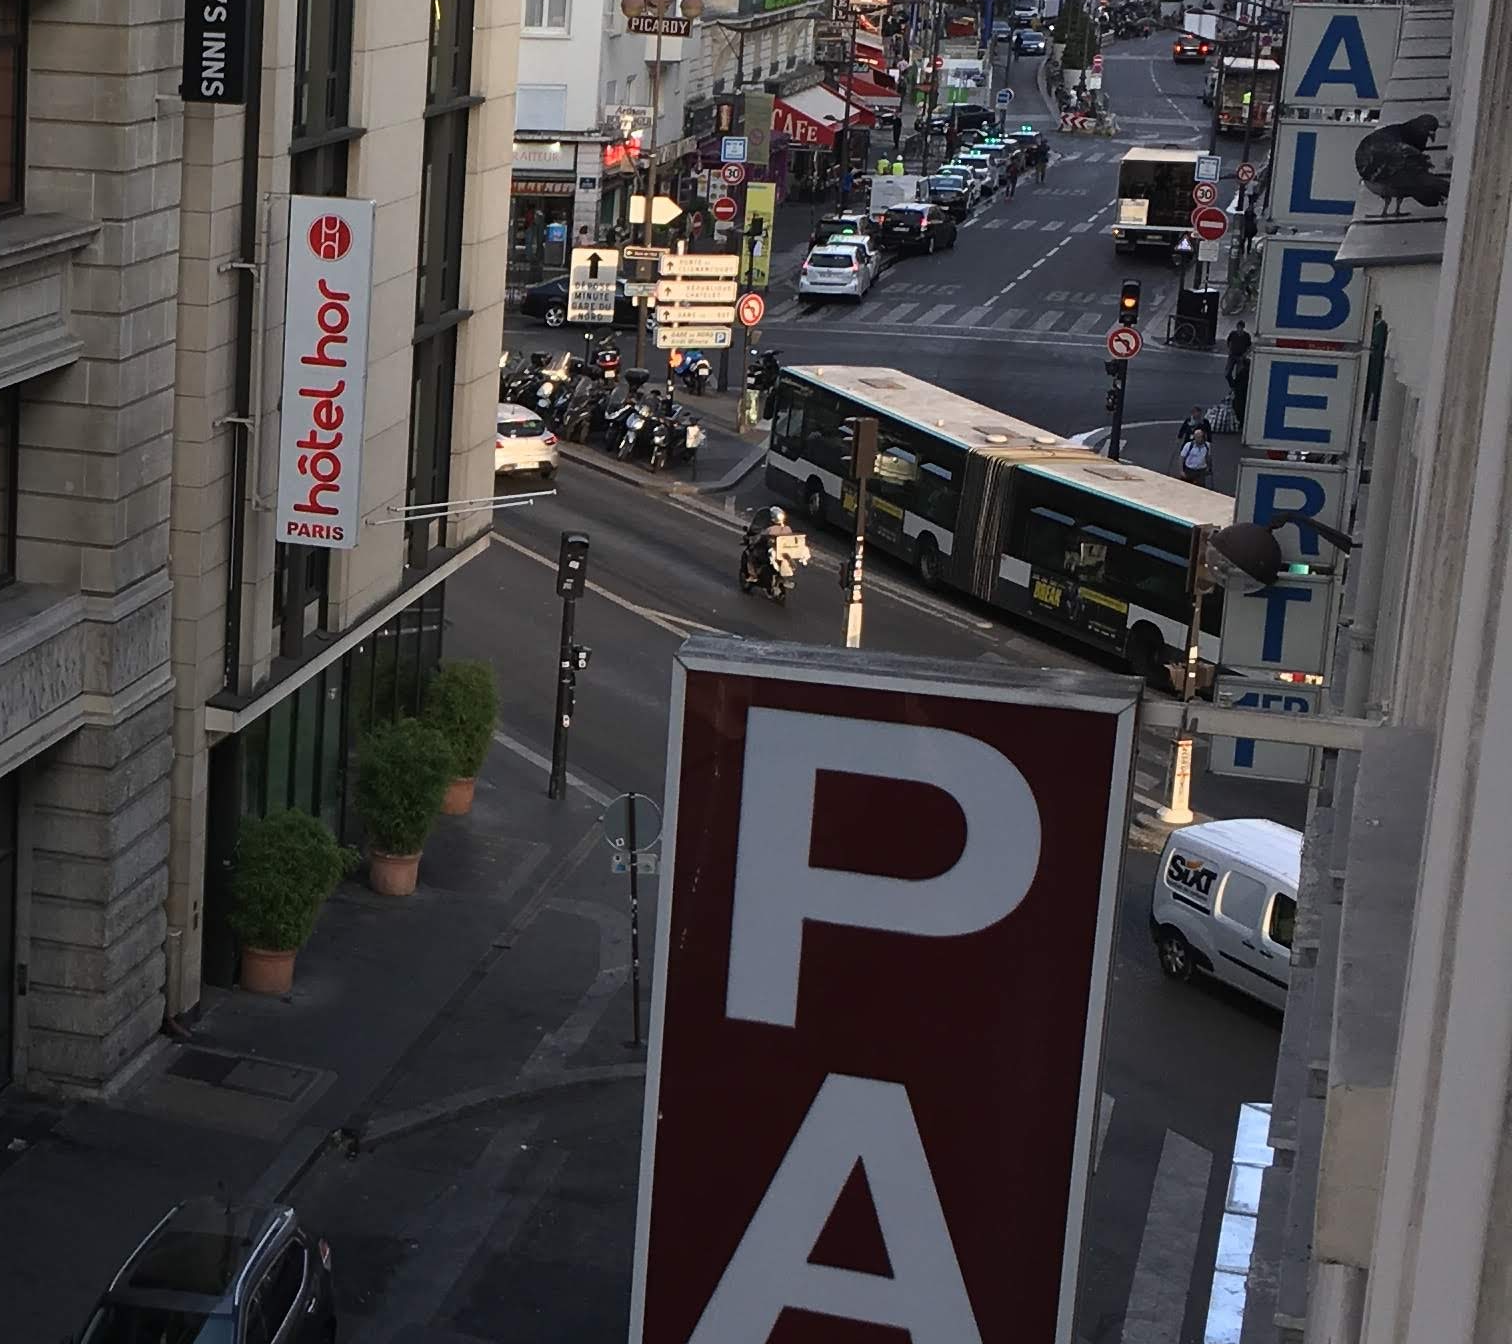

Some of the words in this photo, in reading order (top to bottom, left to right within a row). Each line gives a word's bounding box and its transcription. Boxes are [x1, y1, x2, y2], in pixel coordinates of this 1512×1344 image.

[630, 16, 690, 35] PICARDY
[200, 33, 225, 98] INNS
[727, 168, 738, 179] 30
[1199, 189, 1212, 200] 30
[574, 292, 610, 302] MINUTE
[300, 278, 351, 367] hor
[1244, 16, 1379, 664] ALBERT
[292, 379, 346, 516] hôtel
[286, 520, 344, 541] PARIS
